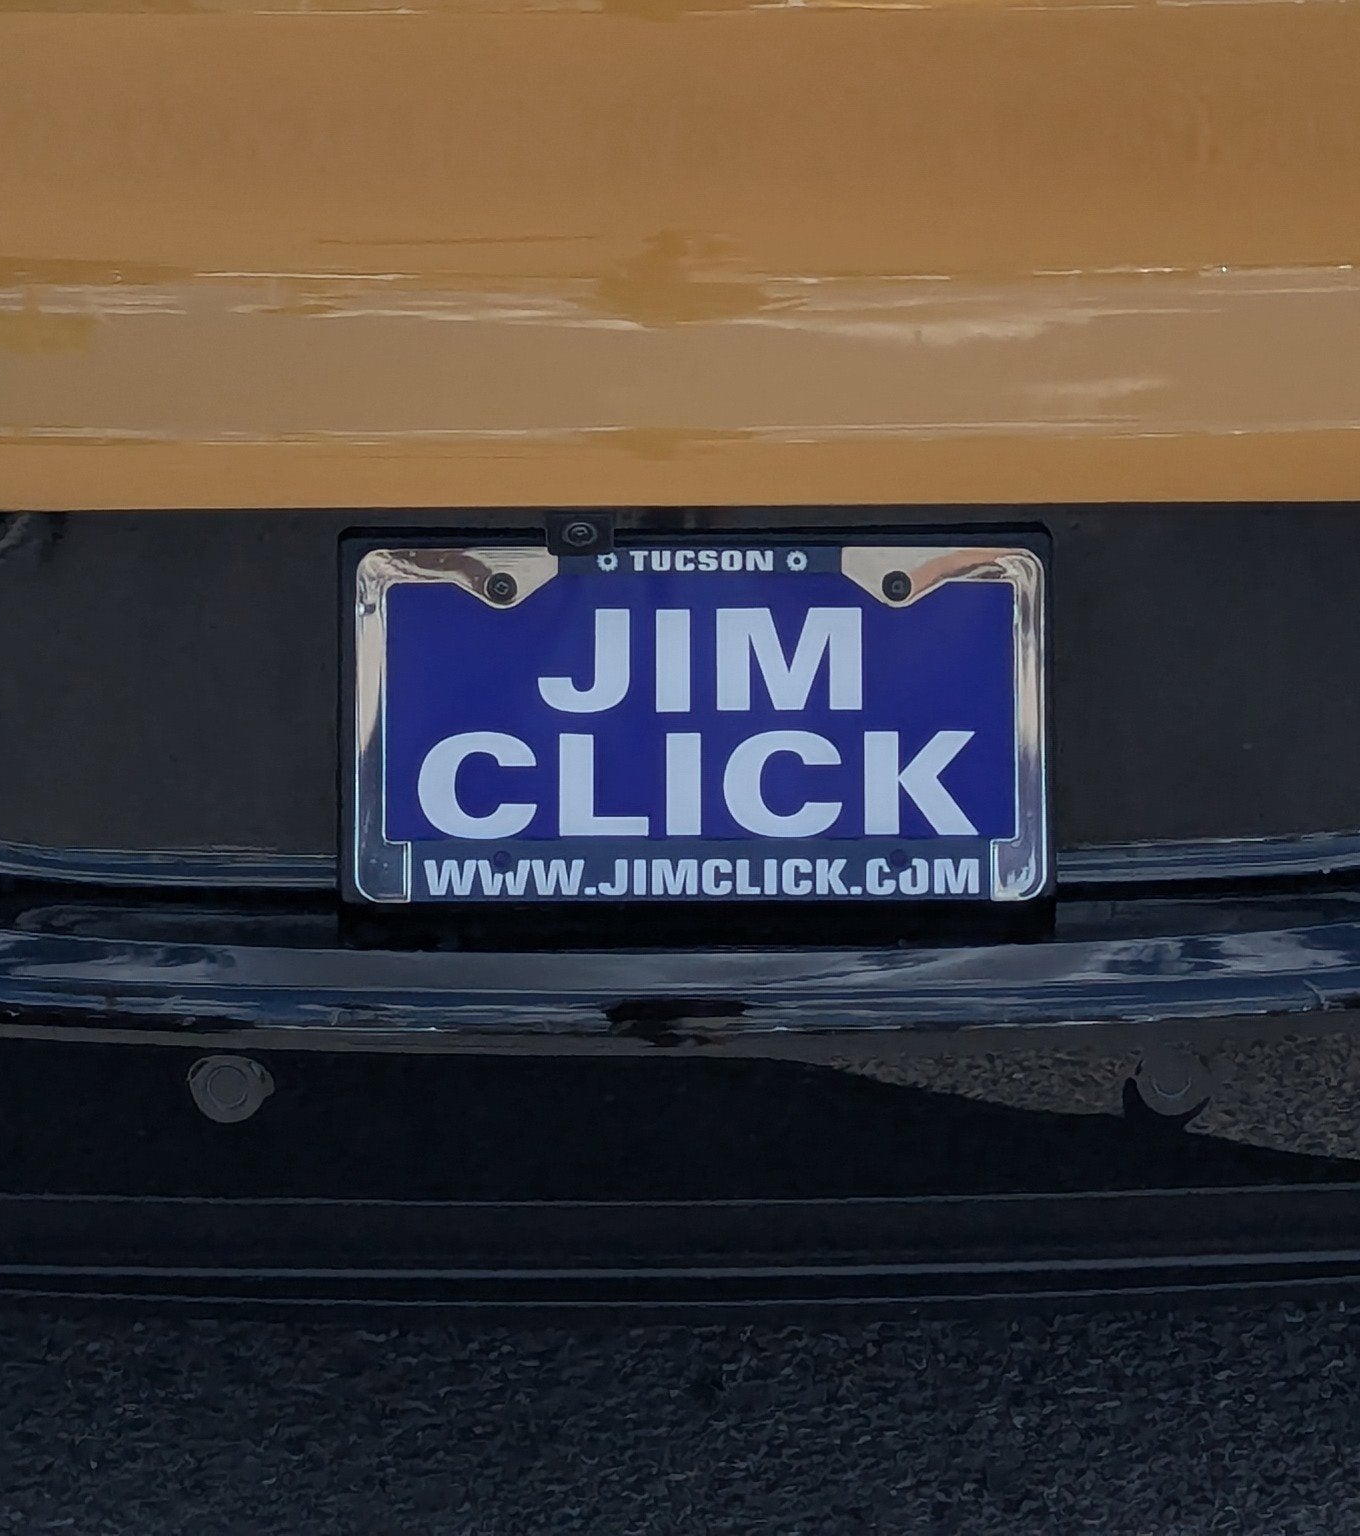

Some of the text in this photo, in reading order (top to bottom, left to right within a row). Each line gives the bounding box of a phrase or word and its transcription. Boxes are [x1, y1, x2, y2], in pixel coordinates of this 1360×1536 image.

[629, 550, 774, 572] TUCSON
[538, 607, 863, 713] JIM
[417, 730, 980, 840] CLICK
[424, 858, 981, 896] WWW.JIMCLICK.COM
